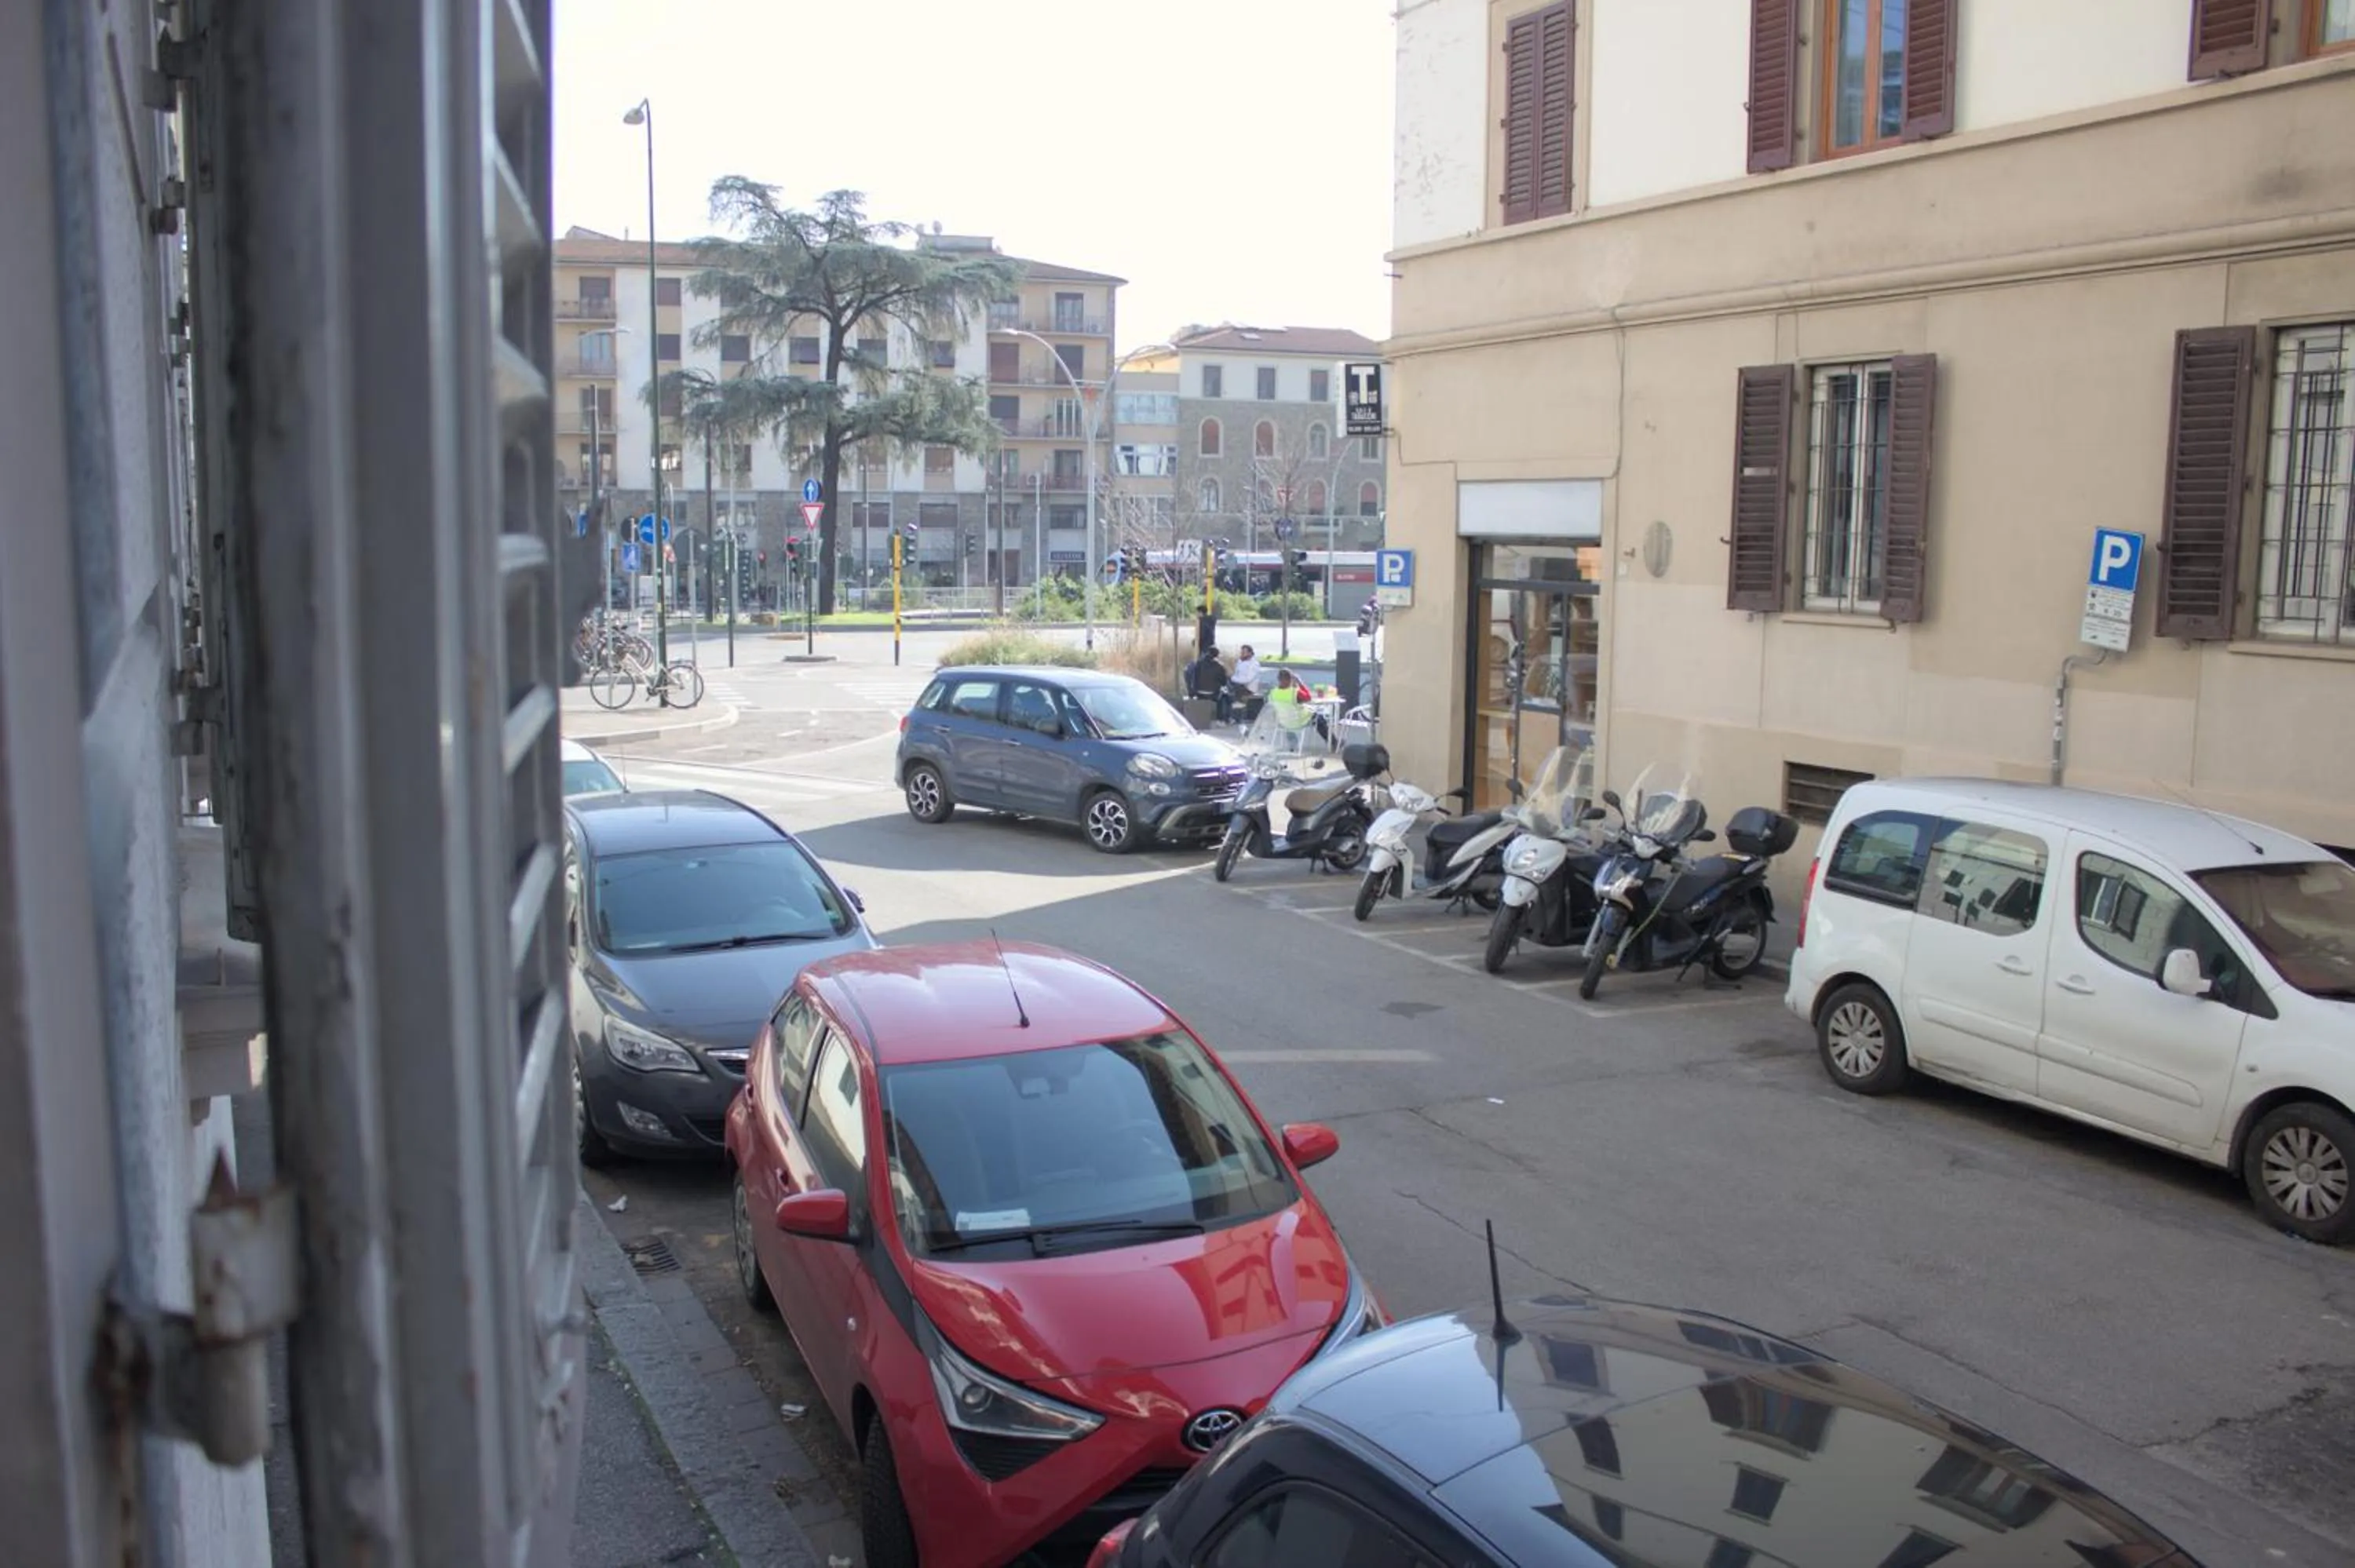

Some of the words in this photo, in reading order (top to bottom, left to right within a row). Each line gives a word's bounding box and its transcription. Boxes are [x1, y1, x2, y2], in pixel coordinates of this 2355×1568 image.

[1351, 366, 1375, 404] T
[1383, 553, 1405, 582] P
[2098, 534, 2131, 582] P
